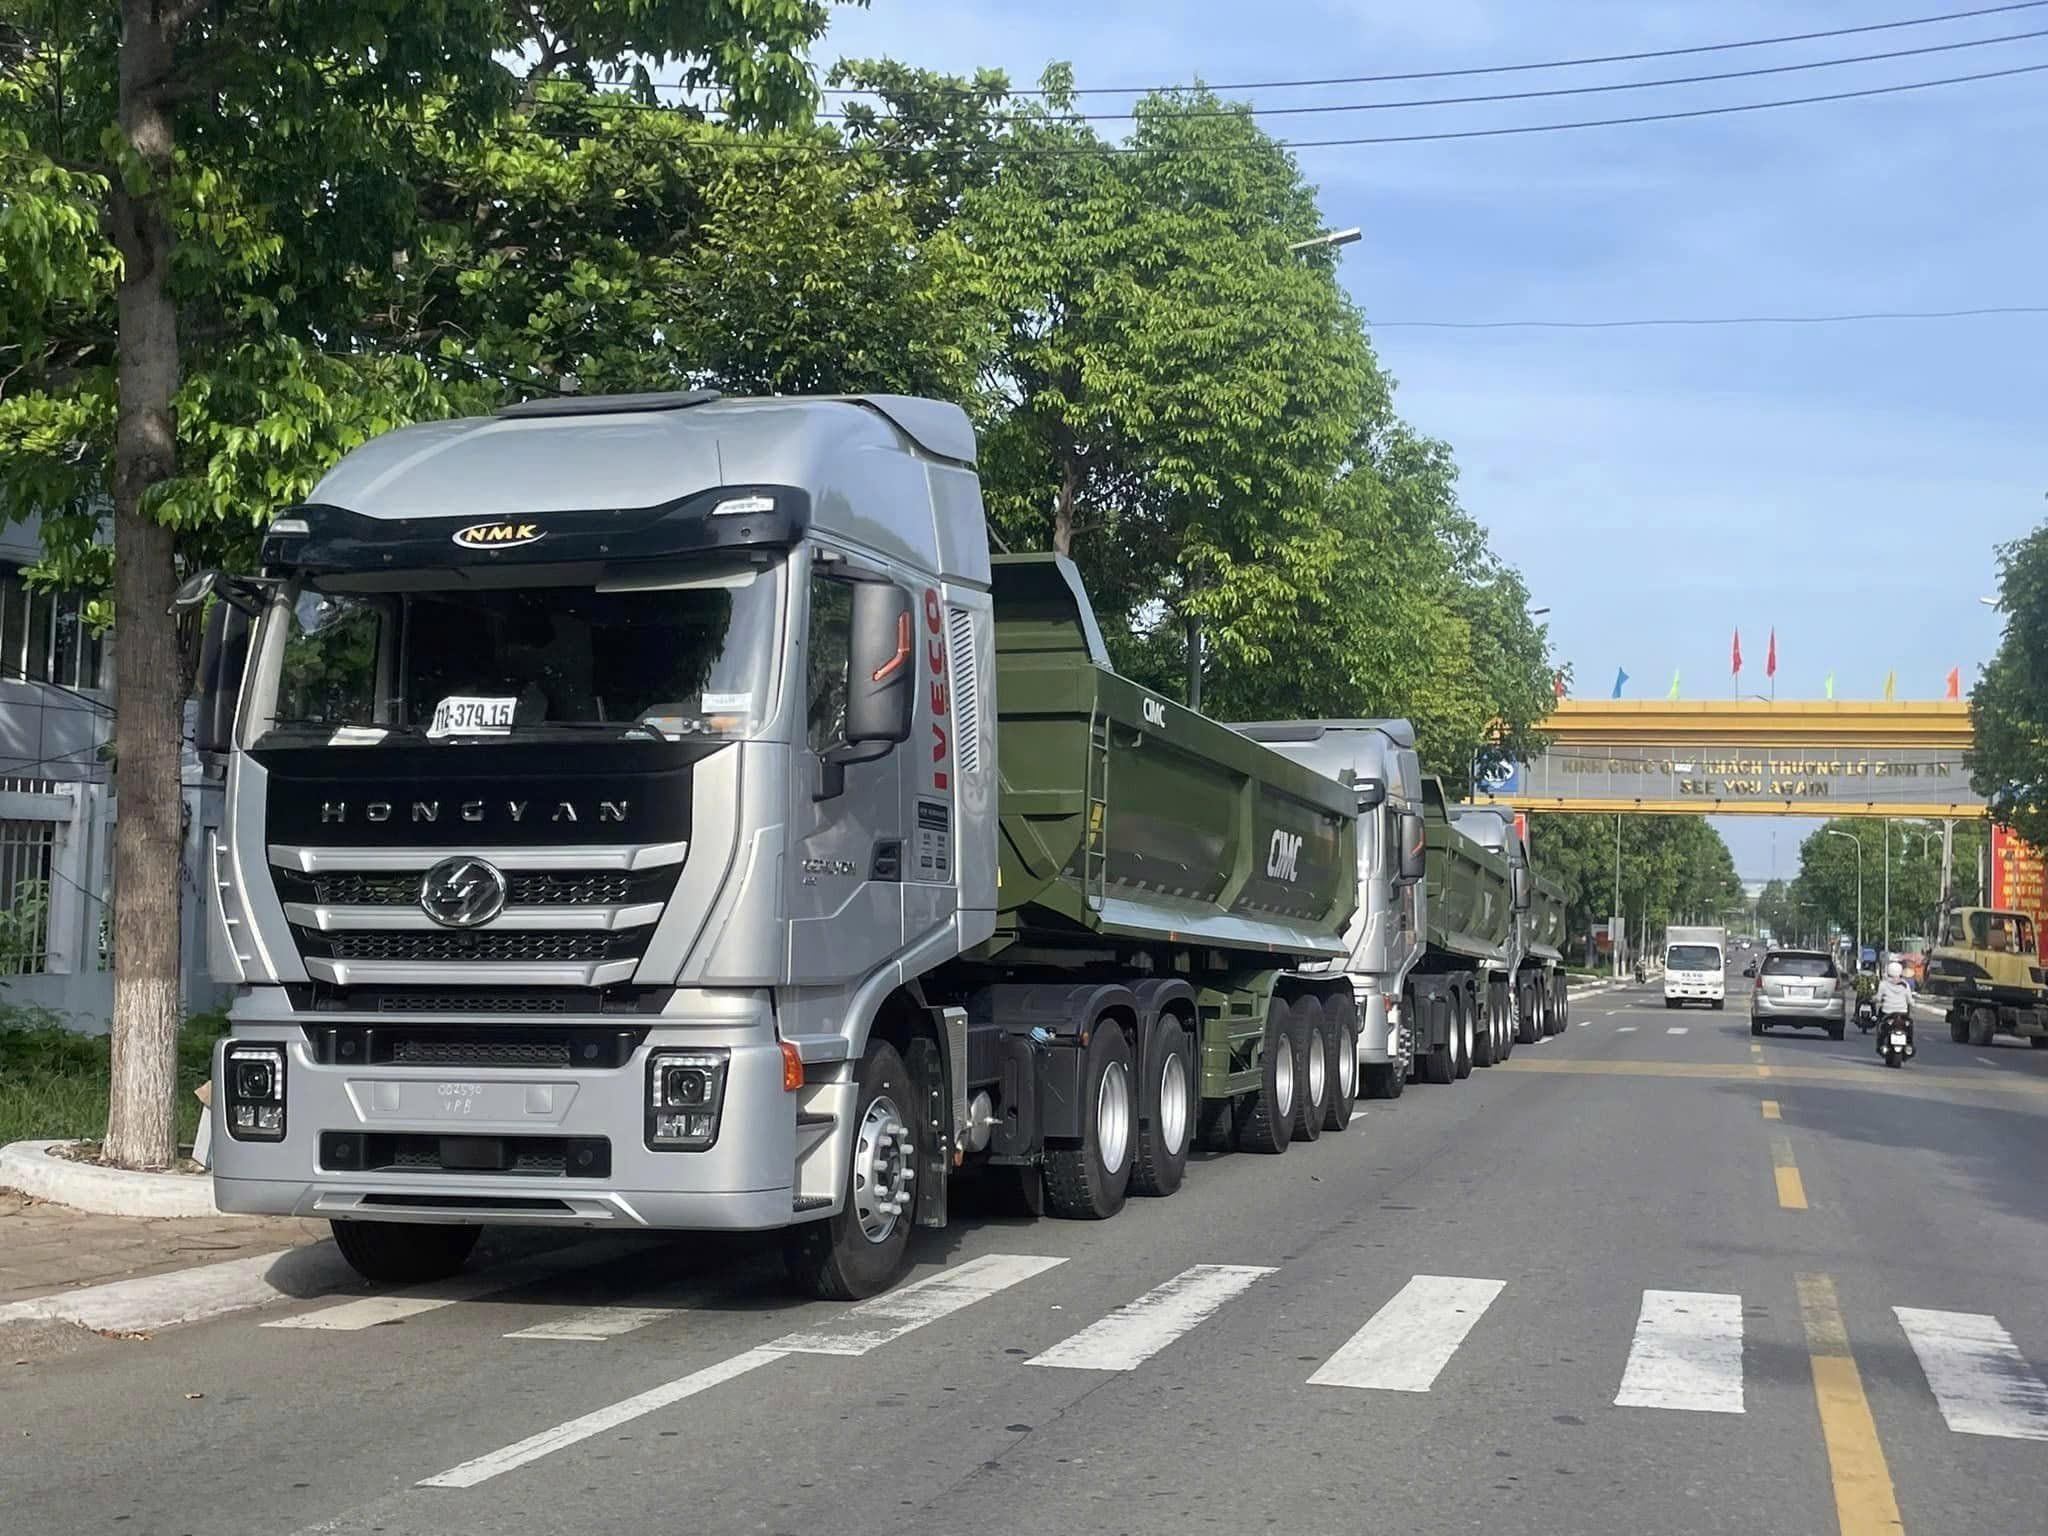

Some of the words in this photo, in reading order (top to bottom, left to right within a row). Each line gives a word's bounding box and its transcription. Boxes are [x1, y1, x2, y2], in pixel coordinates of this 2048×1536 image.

[465, 525, 537, 542] NMK
[925, 588, 948, 790] IVECO
[1143, 697, 1166, 728] CIMC
[1680, 779, 1717, 795] SEE
[1723, 779, 1762, 794] YOU
[1769, 780, 1829, 796] AGAIN
[321, 800, 628, 823] HONGYAN
[1266, 828, 1303, 882] CIMC
